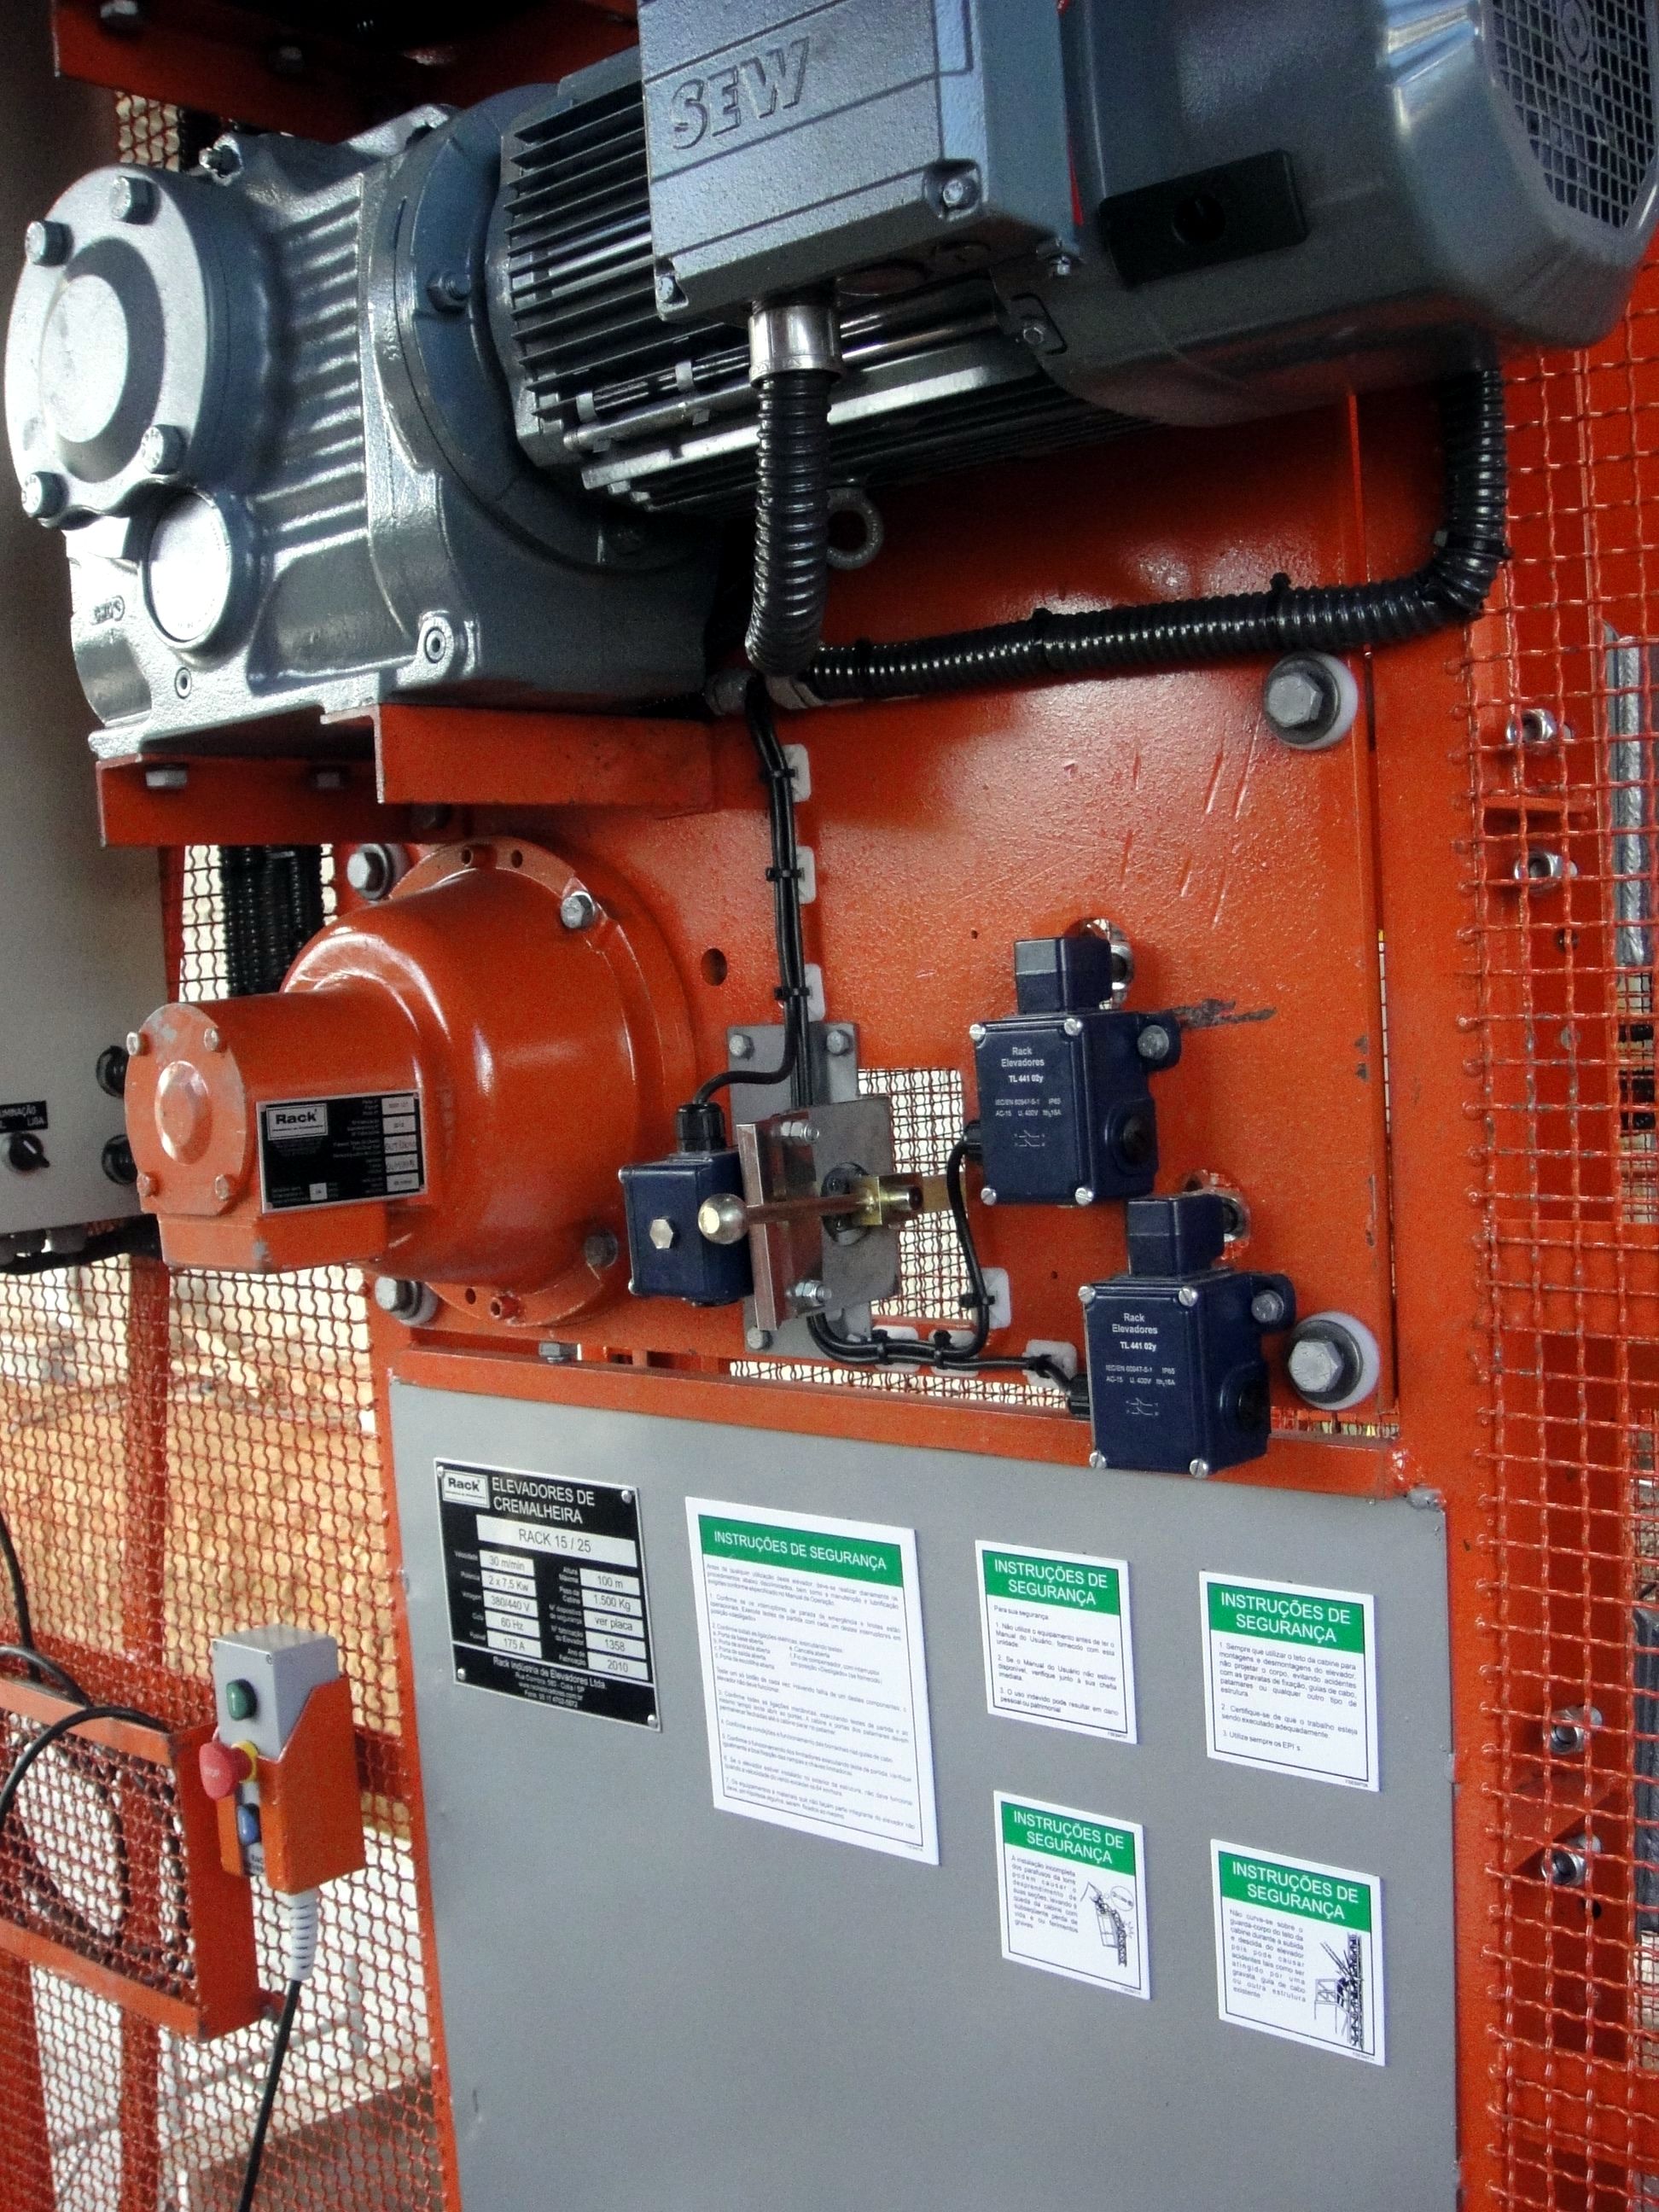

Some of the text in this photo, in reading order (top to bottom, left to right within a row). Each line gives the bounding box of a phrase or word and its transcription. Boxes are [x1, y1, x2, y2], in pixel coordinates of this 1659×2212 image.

[669, 36, 809, 149] SEW
[1012, 1046, 1032, 1056] Rack
[1001, 1058, 1045, 1068] Elevadores
[276, 1111, 317, 1125] Rack
[1124, 1313, 1144, 1322] Rack
[1112, 1324, 1158, 1334] Elevadores
[1130, 1342, 1143, 1350] 441
[448, 1478, 480, 1492] Rack
[492, 1477, 595, 1506] ELEVADORES DE
[493, 1496, 583, 1524] CREMALHEIRA
[519, 1528, 551, 1546] RACK
[555, 1535, 567, 1549] 15
[578, 1538, 591, 1553] 25
[713, 1530, 887, 1571] INSTRUÇÕES DE SEGURANÇA
[489, 1555, 498, 1566] 30
[489, 1575, 493, 1585] 2
[597, 1575, 613, 1586] 100
[994, 1558, 1108, 1589] INSTRUÇÕES DE
[1008, 1580, 1097, 1607] SEGURANÇA
[523, 1603, 530, 1612] V
[619, 1598, 631, 1612] Kg
[1221, 1592, 1351, 1625] INSTRUÇÕES DE
[513, 1621, 524, 1631] Hz
[595, 1617, 633, 1631] ver placa
[1236, 1614, 1337, 1644] SEGURANÇA
[504, 1638, 525, 1651] 175 A
[605, 1639, 626, 1652] 1358
[493, 1656, 509, 1668] Rack
[550, 1669, 589, 1685] Elevadores
[608, 1659, 629, 1673] 2010
[1014, 1810, 1125, 1849] INSTRUÇÕES DE
[1027, 1831, 1113, 1865] SEGURANÇA
[1232, 1860, 1359, 1903] INSTRUÇÕES DE
[1247, 1883, 1346, 1919] SEGURANÇA
